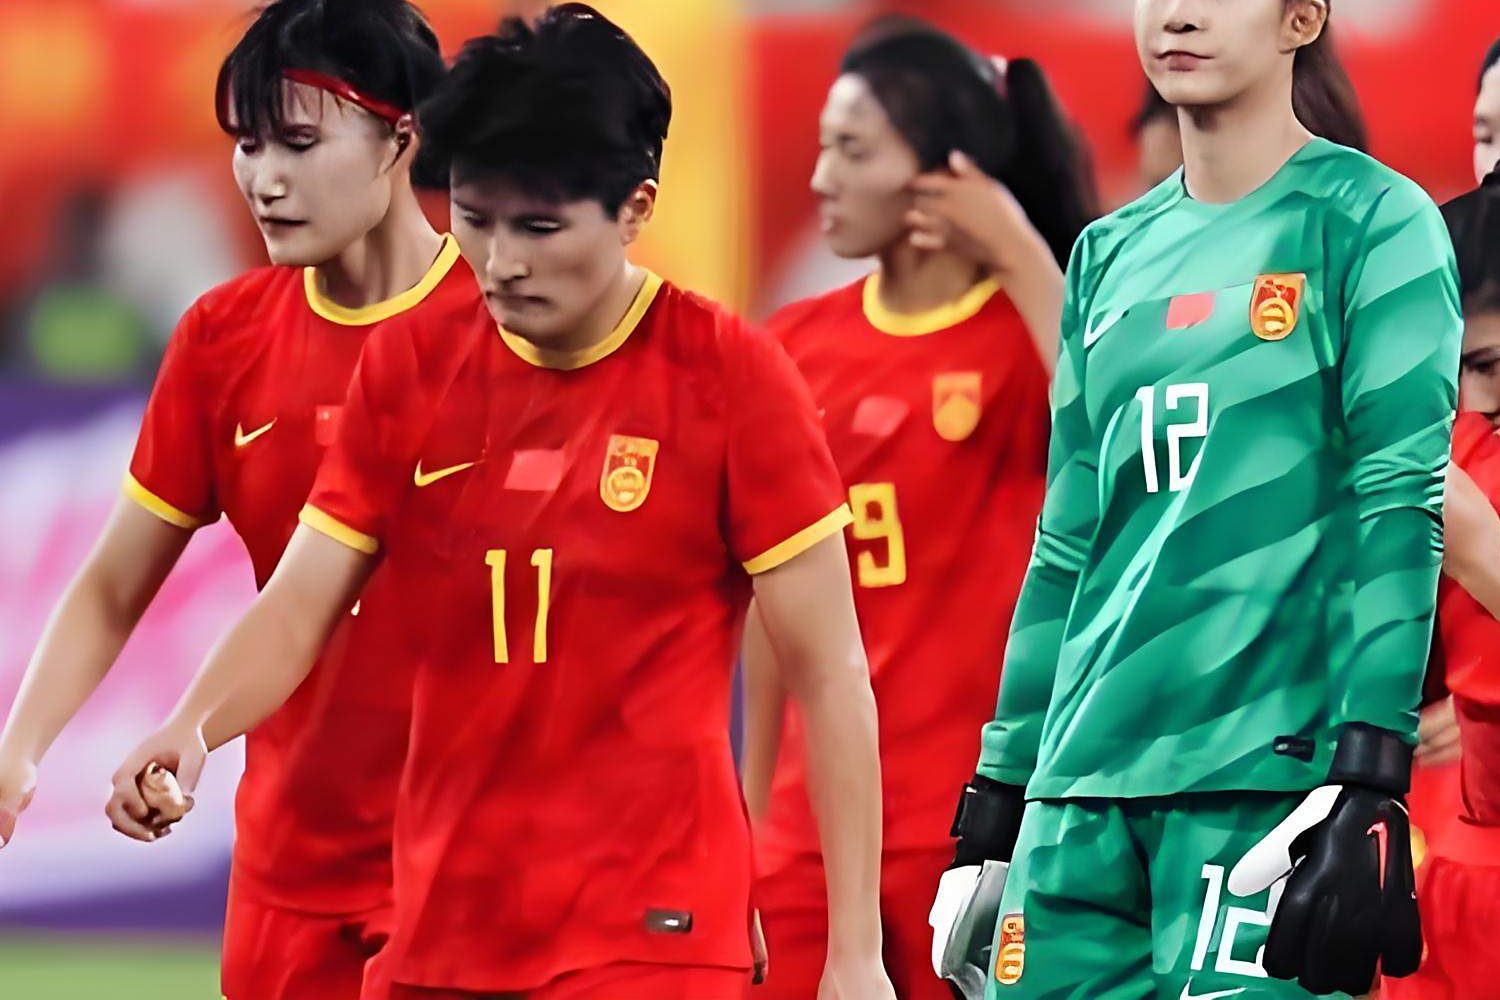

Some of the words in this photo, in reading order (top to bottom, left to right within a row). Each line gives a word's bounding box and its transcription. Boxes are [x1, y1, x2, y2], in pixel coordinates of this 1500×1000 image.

[1135, 382, 1209, 491] 12
[849, 483, 906, 587] 9
[485, 548, 553, 663] 11
[1190, 863, 1286, 978] 12
